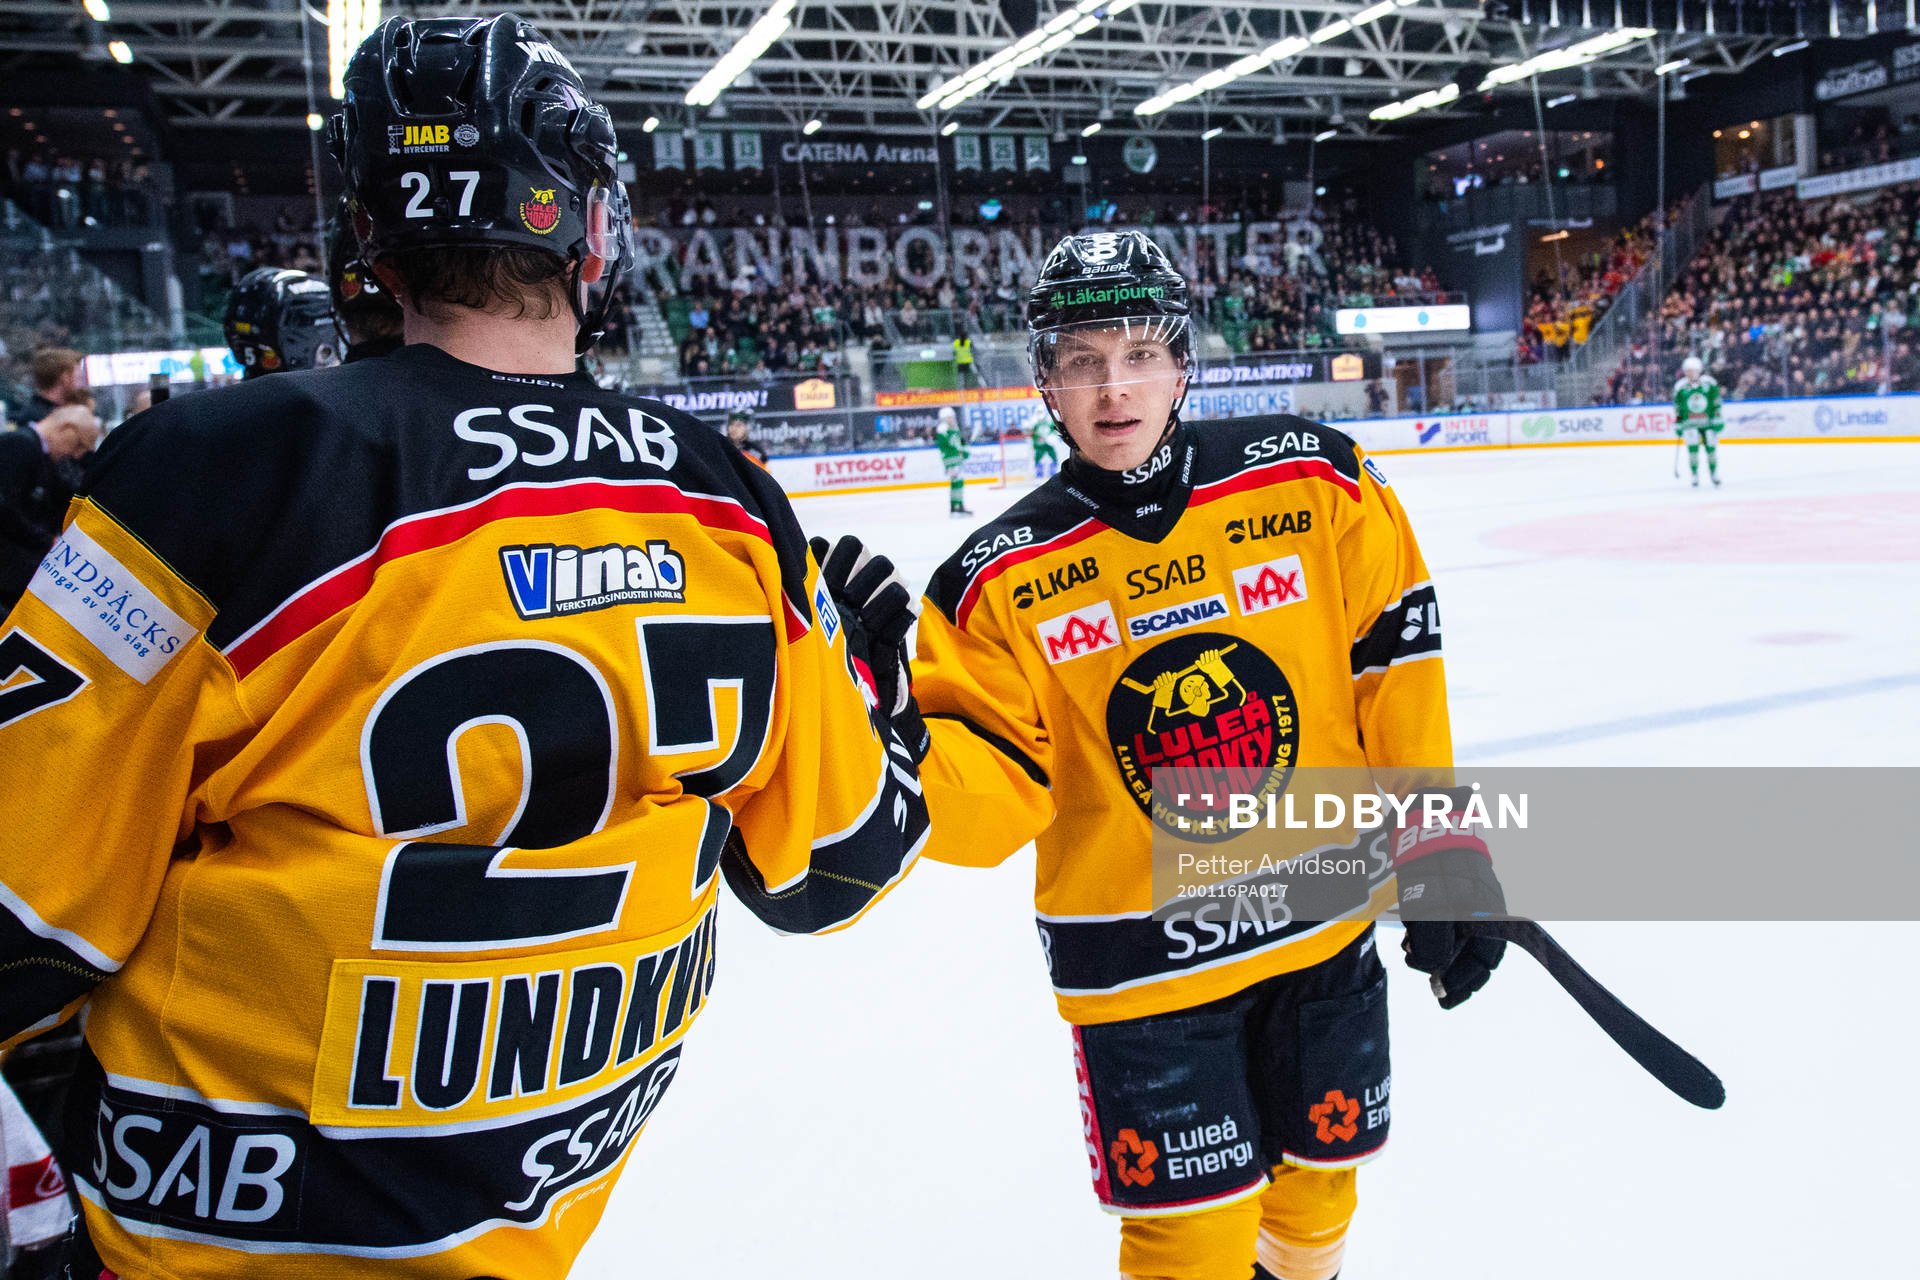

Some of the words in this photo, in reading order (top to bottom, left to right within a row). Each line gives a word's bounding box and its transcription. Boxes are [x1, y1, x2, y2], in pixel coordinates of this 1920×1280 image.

[403, 125, 450, 145] JIAB
[403, 145, 450, 154] HYRCENTER
[781, 142, 869, 162] CATENA
[874, 142, 939, 162] Arena
[400, 171, 480, 219] 27
[1066, 286, 1164, 306] Läkarjouren
[453, 404, 678, 481] SSAB
[1559, 417, 1603, 433] suez
[815, 456, 906, 475] FLYTGOLV
[1121, 445, 1172, 485] SSAB
[1244, 432, 1320, 465] SSAB
[1136, 503, 1163, 518] SHL
[1248, 510, 1312, 540] LKAB
[961, 526, 1034, 577] SSAB
[503, 544, 683, 616] Vinab
[1035, 556, 1100, 601] LKAB
[1126, 554, 1206, 600] SSAB
[1239, 565, 1301, 613] MAX
[555, 590, 648, 612] VERKSTADSINDUSTRI
[1130, 600, 1226, 636] SCANIA
[82, 595, 98, 609] av
[100, 611, 121, 632] alla
[123, 633, 150, 658] slag
[1045, 614, 1115, 661] MAX
[1116, 744, 1154, 806] LULEÅ
[1271, 694, 1293, 737] 1977
[1134, 690, 1271, 765] LULEÅ
[360, 614, 777, 952] 27
[1143, 725, 1273, 812] HOCKEY
[1163, 882, 1293, 961] SSAB
[503, 1055, 681, 1213] SSAB
[1163, 1113, 1239, 1154] Luleå
[1167, 1140, 1254, 1180] Energi
